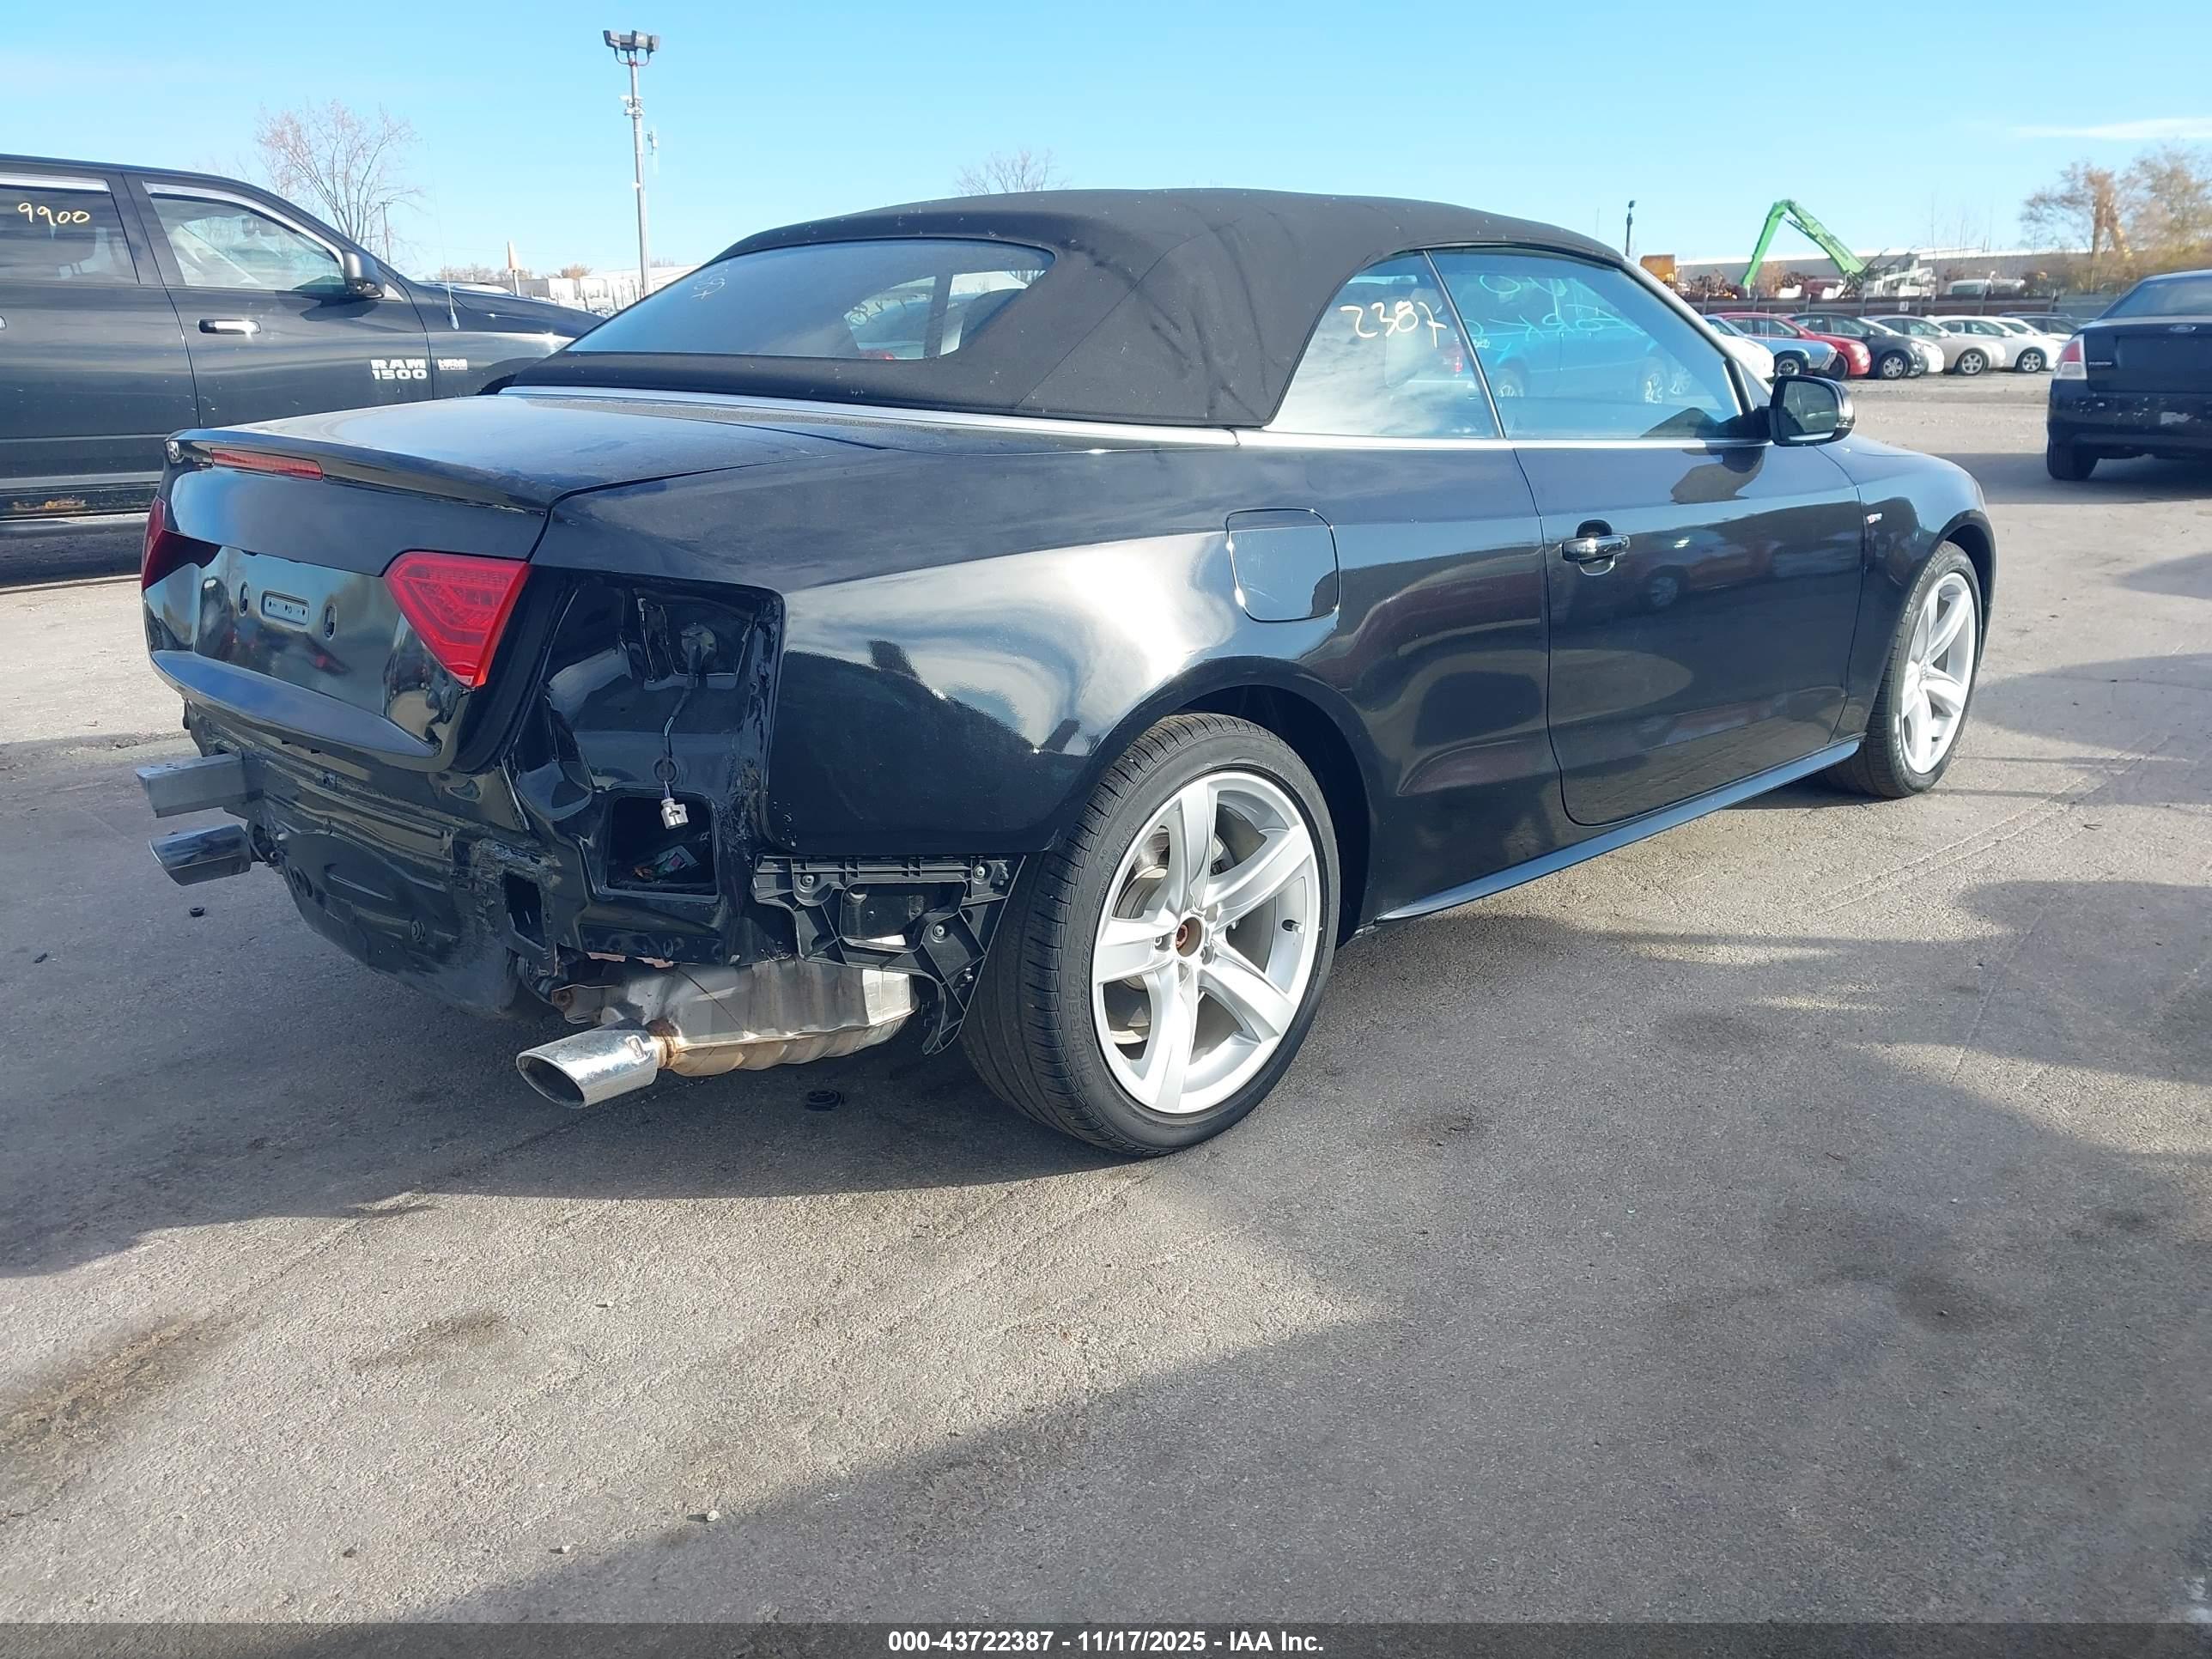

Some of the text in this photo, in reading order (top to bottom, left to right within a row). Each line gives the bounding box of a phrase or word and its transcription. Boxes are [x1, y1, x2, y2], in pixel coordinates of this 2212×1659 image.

[18, 203, 90, 226] 9900
[1340, 301, 1448, 349] 2387
[370, 359, 426, 369] RAM
[371, 369, 428, 380] 1500
